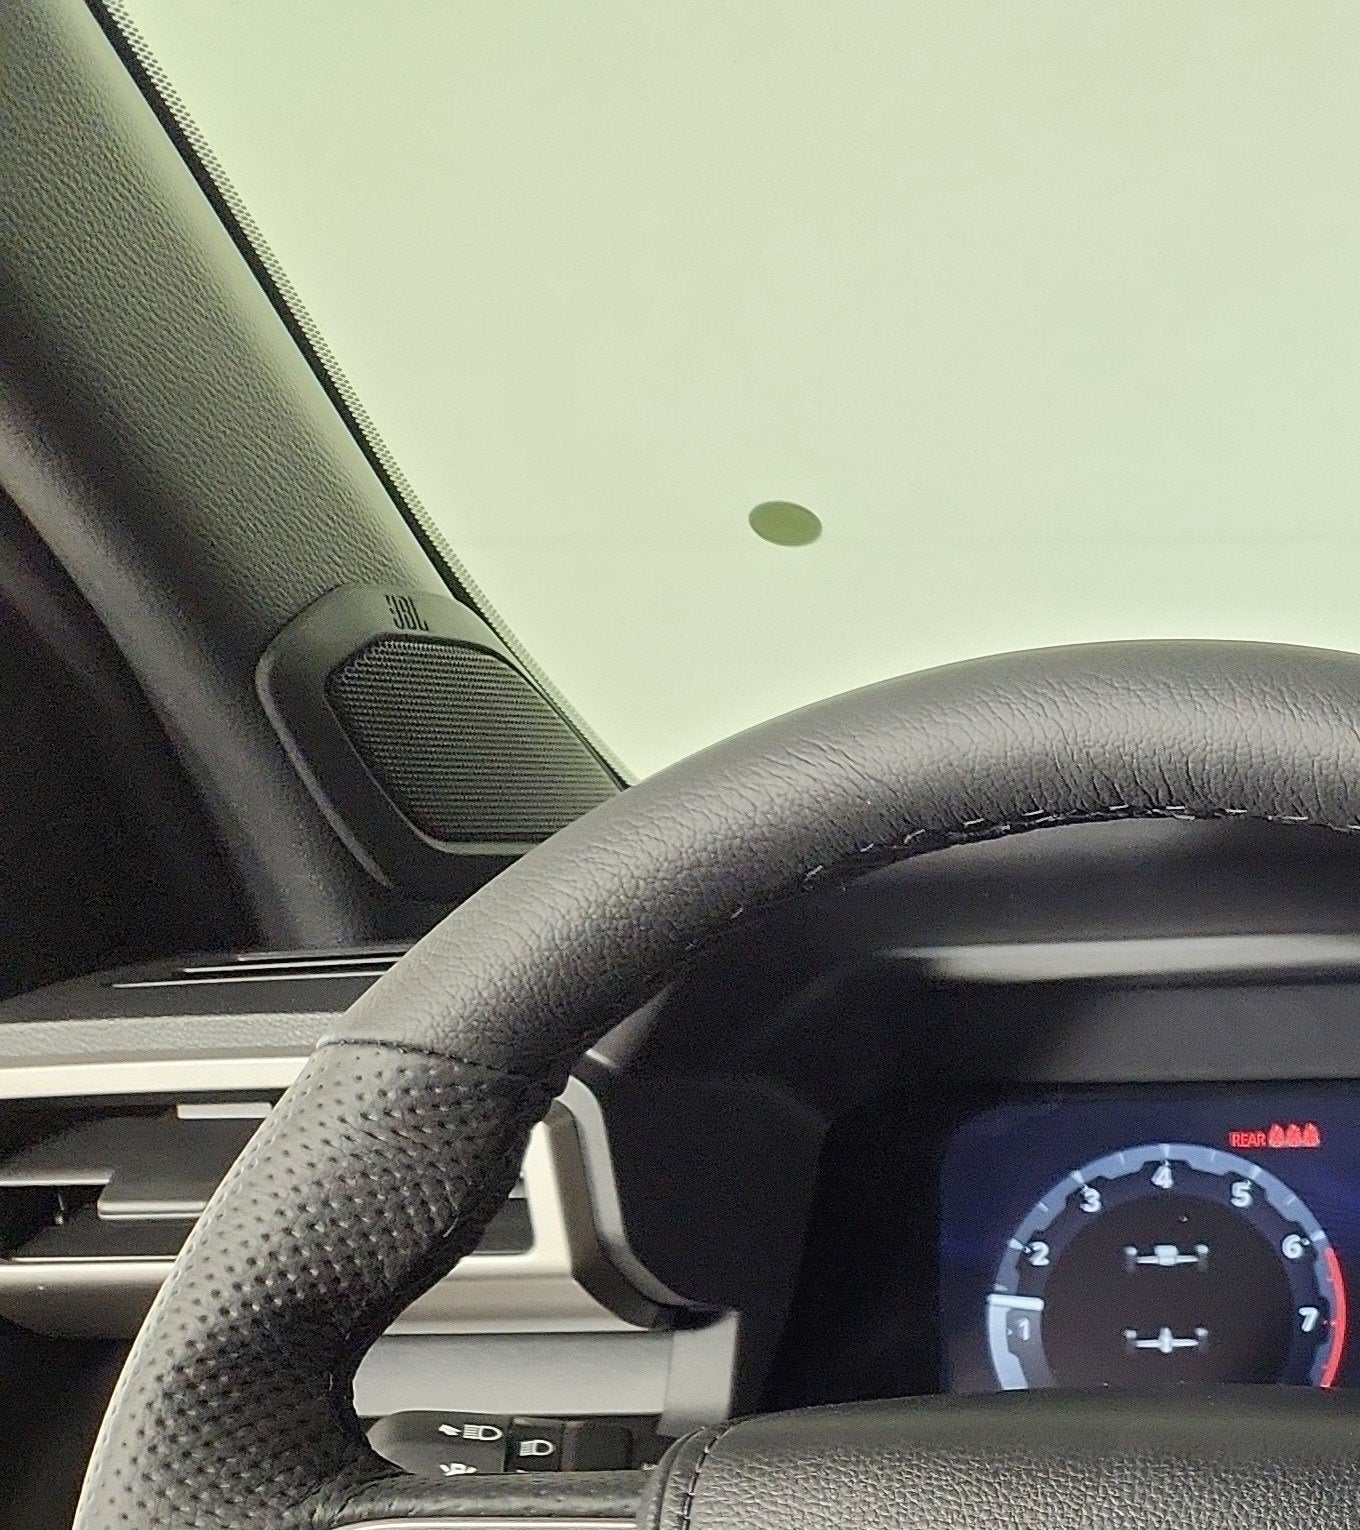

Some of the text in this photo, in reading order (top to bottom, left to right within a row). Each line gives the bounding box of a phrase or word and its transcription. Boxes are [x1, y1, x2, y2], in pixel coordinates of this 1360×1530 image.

[385, 594, 430, 632] JBL
[1230, 1131, 1266, 1148] REAR
[1152, 1165, 1174, 1188] 4
[1080, 1189, 1101, 1213] 3
[1230, 1182, 1252, 1207] 5
[1030, 1242, 1051, 1265] 2
[1282, 1235, 1302, 1259] 6
[1015, 1320, 1031, 1341] 1
[1301, 1307, 1319, 1331] 7
